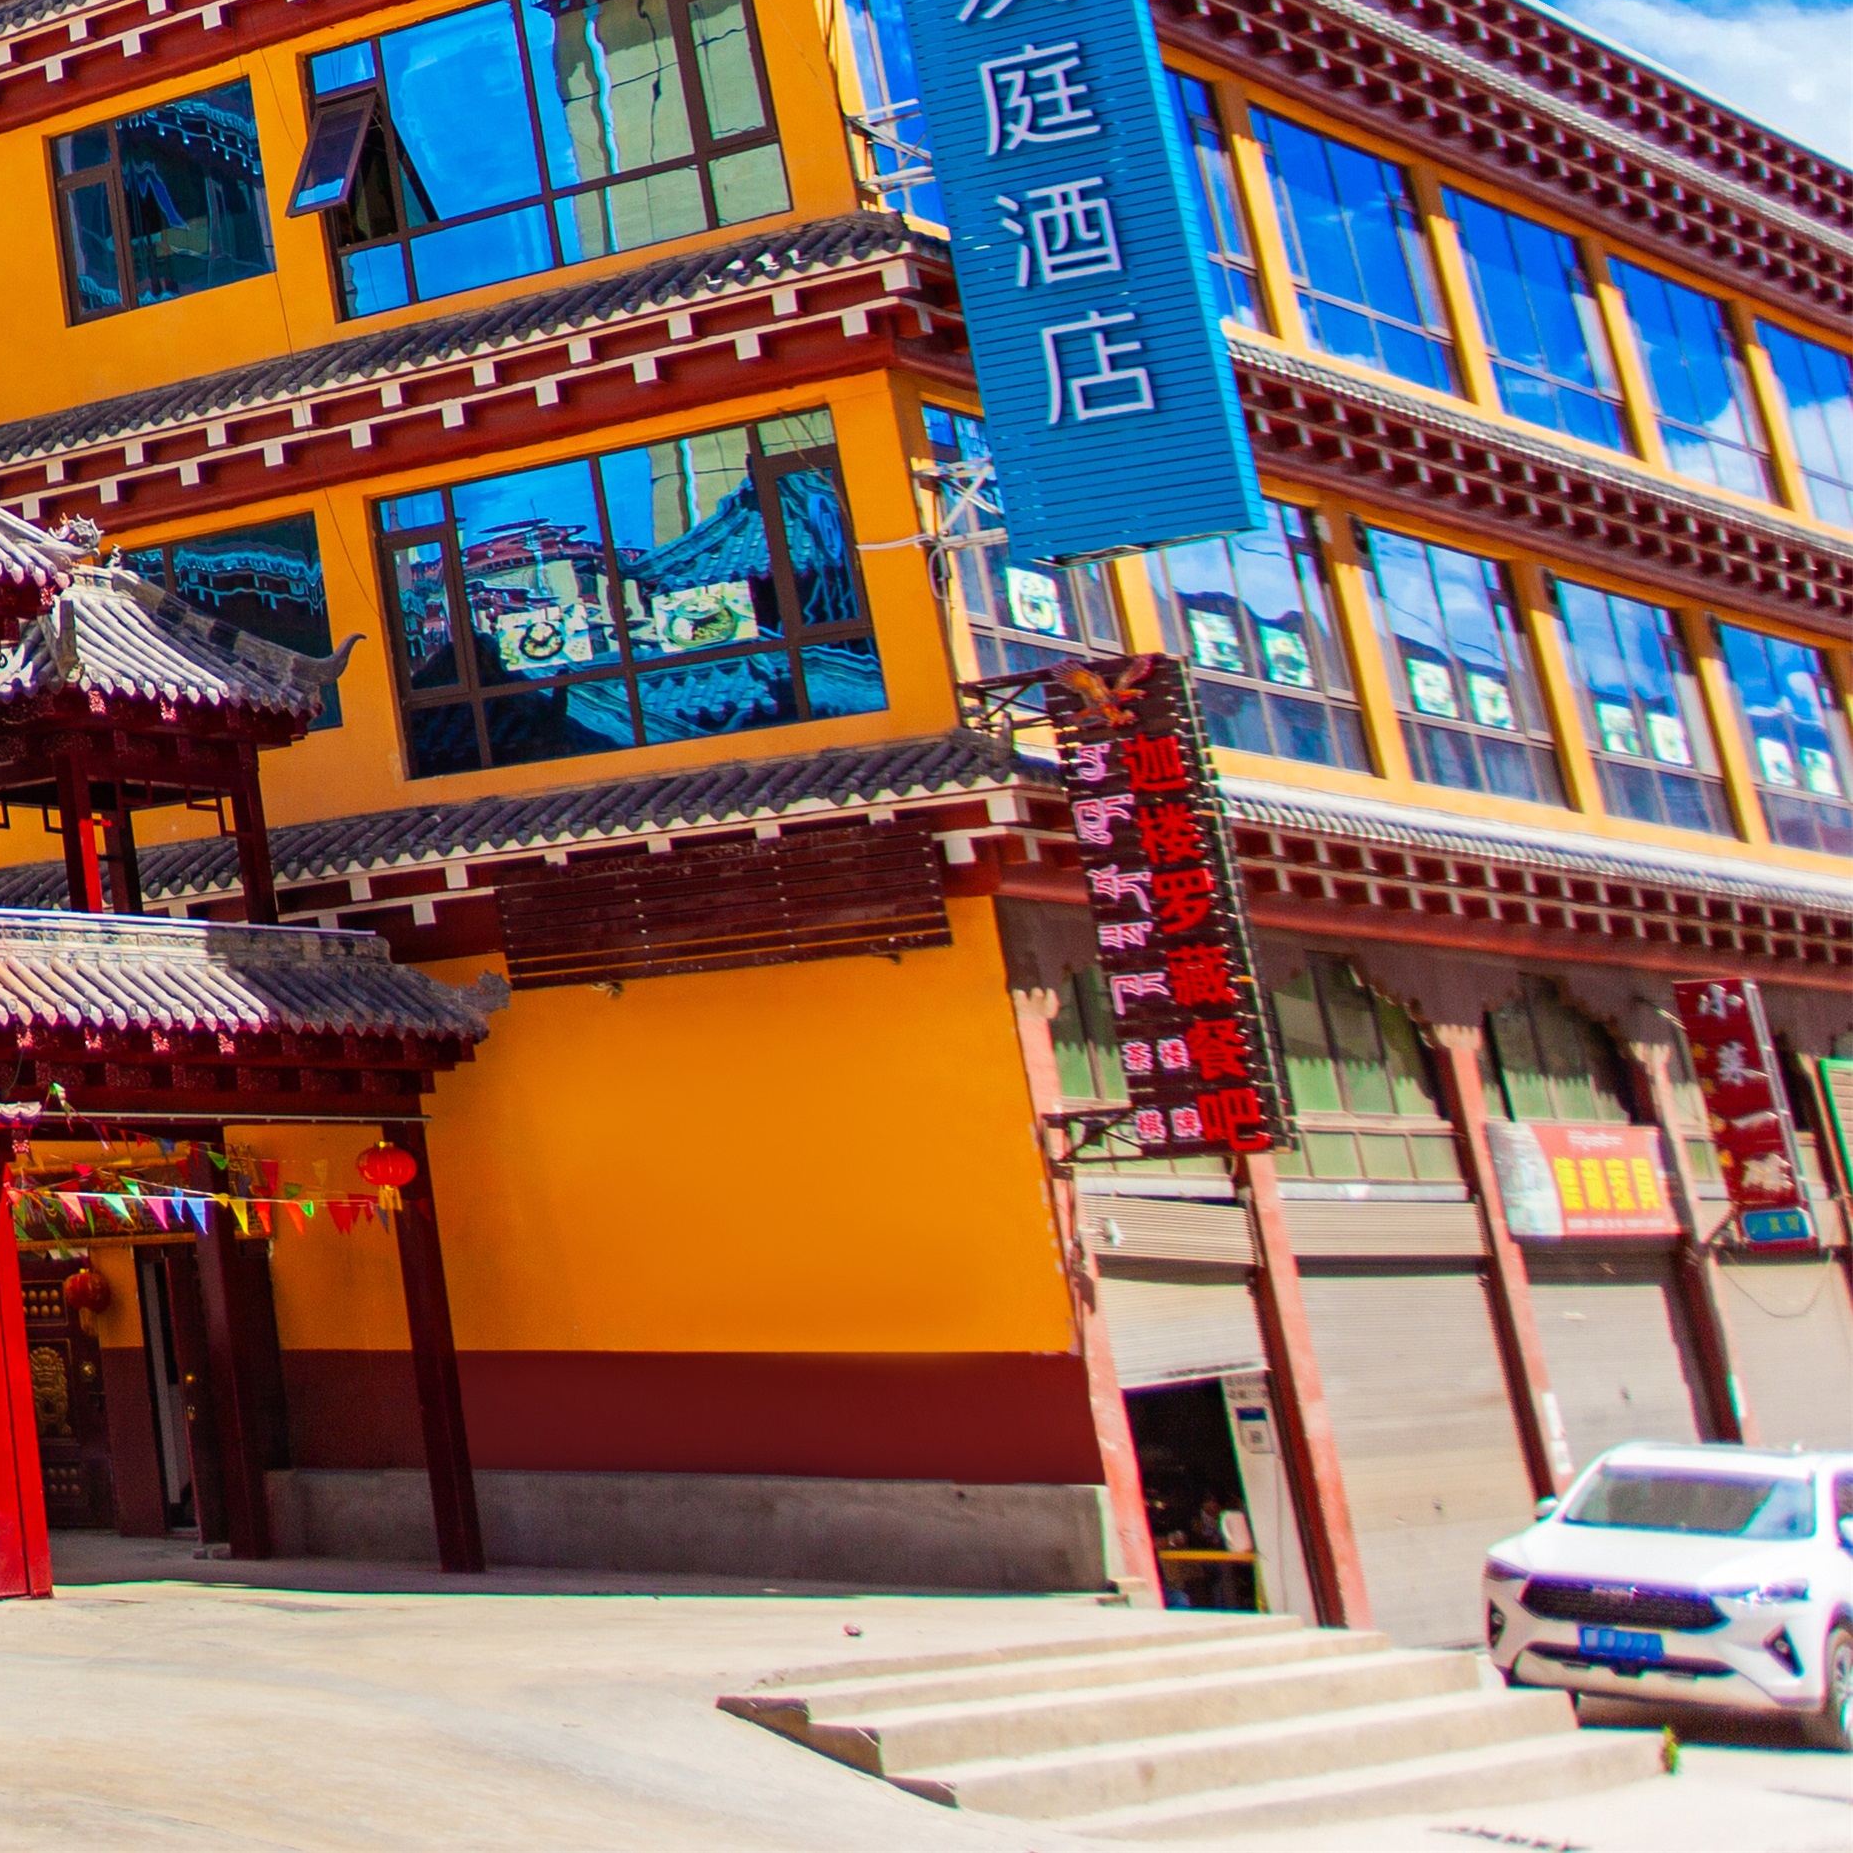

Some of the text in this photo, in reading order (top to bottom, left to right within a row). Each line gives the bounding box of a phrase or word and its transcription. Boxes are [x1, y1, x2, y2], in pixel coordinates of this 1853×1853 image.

[1120, 733, 1273, 1152] 迦楼罗藏餐吧
